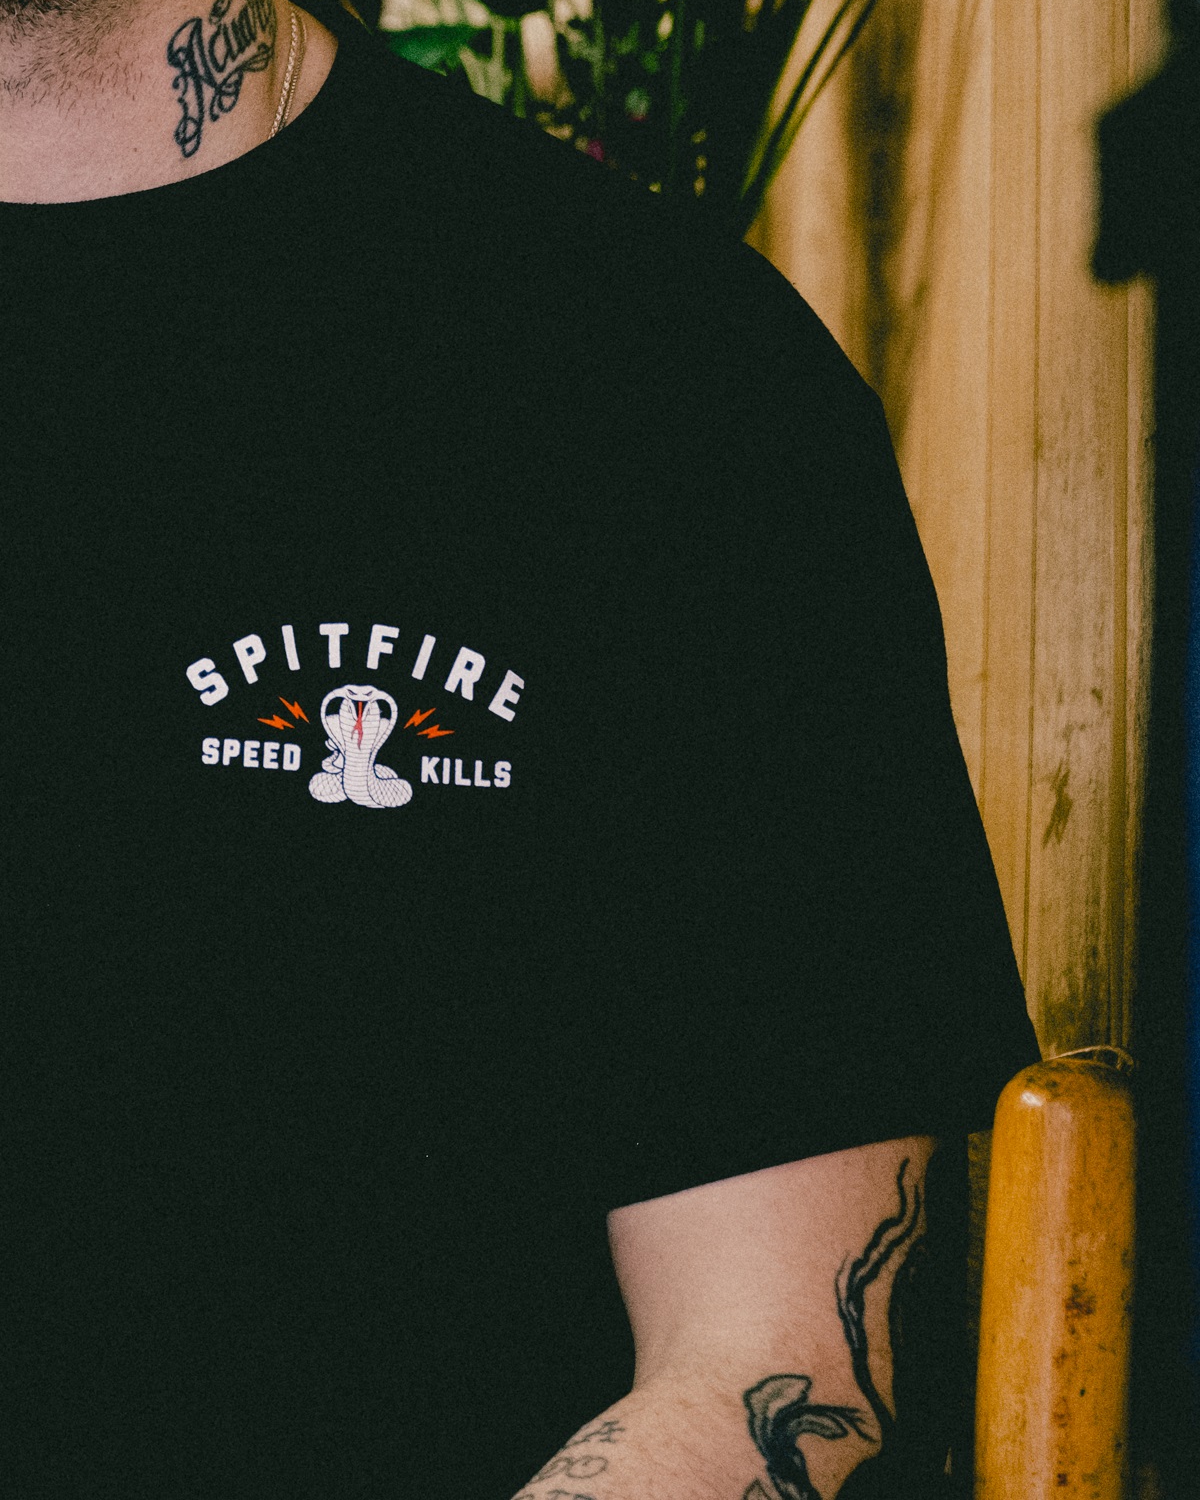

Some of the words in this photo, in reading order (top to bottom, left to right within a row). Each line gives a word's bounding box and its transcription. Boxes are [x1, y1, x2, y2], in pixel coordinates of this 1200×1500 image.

[185, 622, 525, 722] SPITFIRE
[201, 737, 302, 772] SPEED
[420, 755, 512, 788] KILLS
